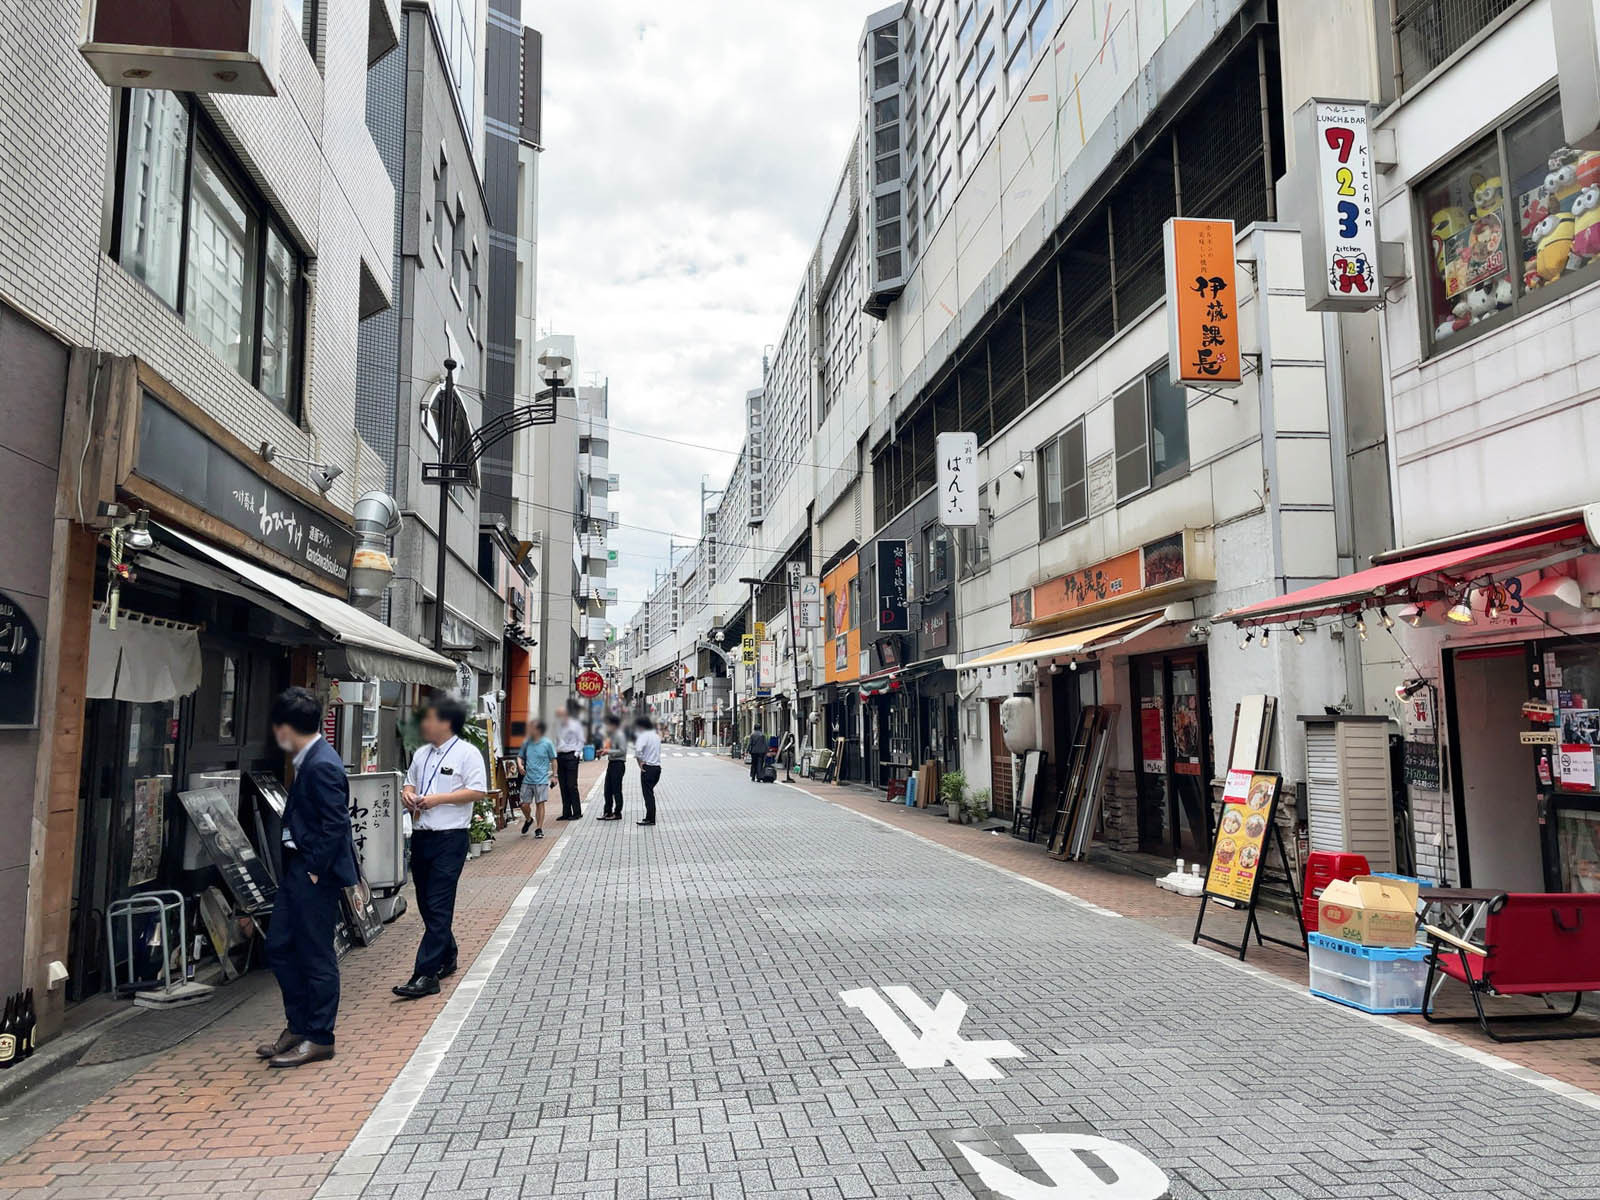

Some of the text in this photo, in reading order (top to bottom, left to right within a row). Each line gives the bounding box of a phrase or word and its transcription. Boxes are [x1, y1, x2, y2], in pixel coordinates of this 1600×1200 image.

[1325, 127, 1360, 238] 723
[1359, 145, 1372, 228] Kitchen
[1335, 257, 1366, 275] 723
[259, 488, 303, 552] わびすけ
[743, 637, 754, 662] 印鑑
[578, 681, 601, 691] 180円
[1521, 735, 1557, 743] OPEN
[372, 800, 382, 829] 天ぷら
[348, 797, 369, 865] わびす
